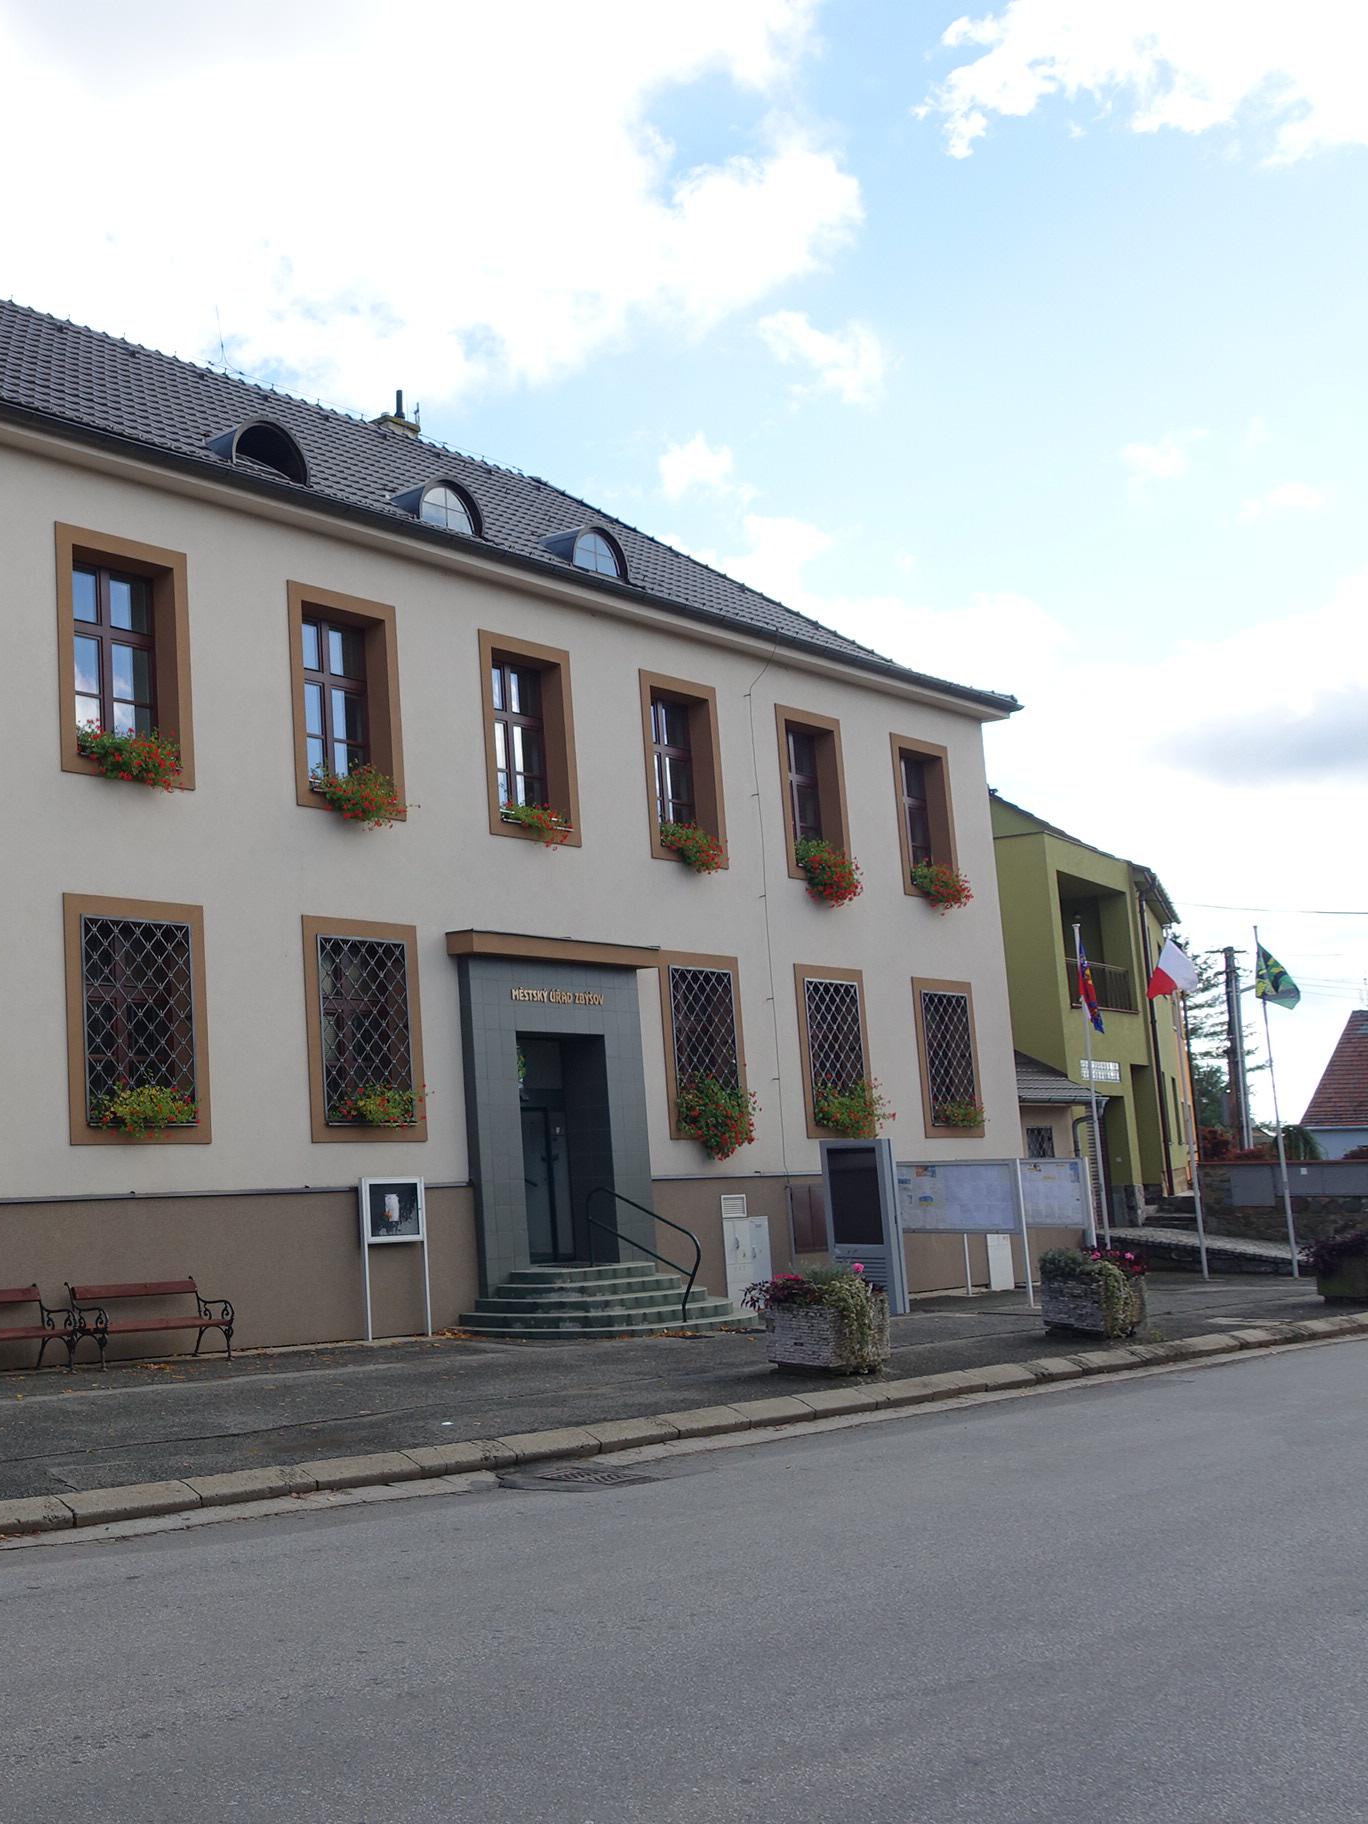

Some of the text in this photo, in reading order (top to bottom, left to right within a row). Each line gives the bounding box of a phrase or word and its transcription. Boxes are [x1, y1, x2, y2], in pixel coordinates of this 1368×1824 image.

[511, 986, 604, 1006] MĚSTSKÝ ÚŘAD ZBÝŠOV
